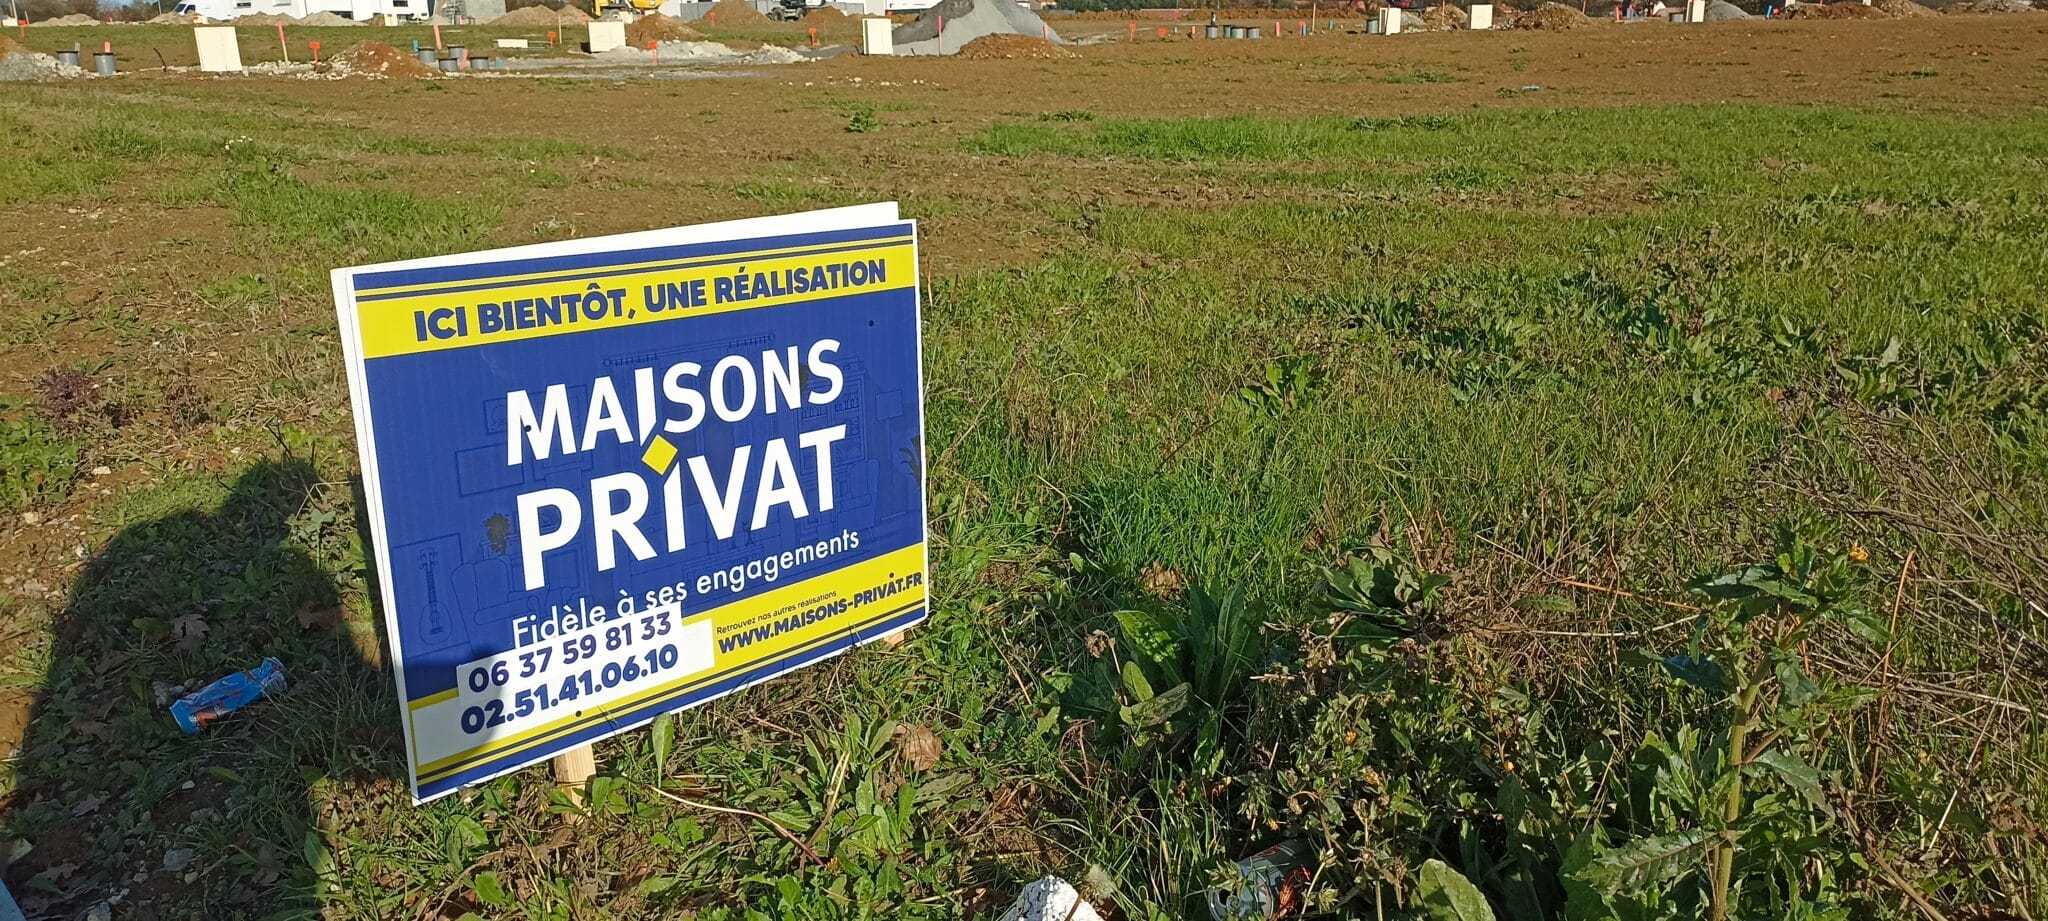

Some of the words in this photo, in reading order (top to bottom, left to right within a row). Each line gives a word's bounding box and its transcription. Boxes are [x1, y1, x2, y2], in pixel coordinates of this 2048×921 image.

[415, 308, 467, 341] ICI
[479, 284, 636, 334] BIENTÔT,
[645, 280, 707, 313] UNE
[715, 259, 886, 303] RÉALISATION
[506, 340, 844, 465] MAISONS
[513, 598, 606, 648] Fidèle
[617, 590, 635, 617] à
[646, 581, 687, 607] ses
[697, 528, 859, 594] engagements
[717, 618, 756, 635] Retrouvez
[757, 612, 772, 622] nos
[774, 604, 797, 616] autres
[798, 590, 837, 608] réalisations
[718, 572, 922, 654] WWW.MAISONS-PRIVAT.FR
[461, 644, 678, 735] 02.51.41.06.10
[469, 660, 509, 693] 06
[520, 646, 553, 677] 37
[562, 634, 597, 664] 59
[605, 622, 634, 651] 81
[640, 612, 672, 640] 33
